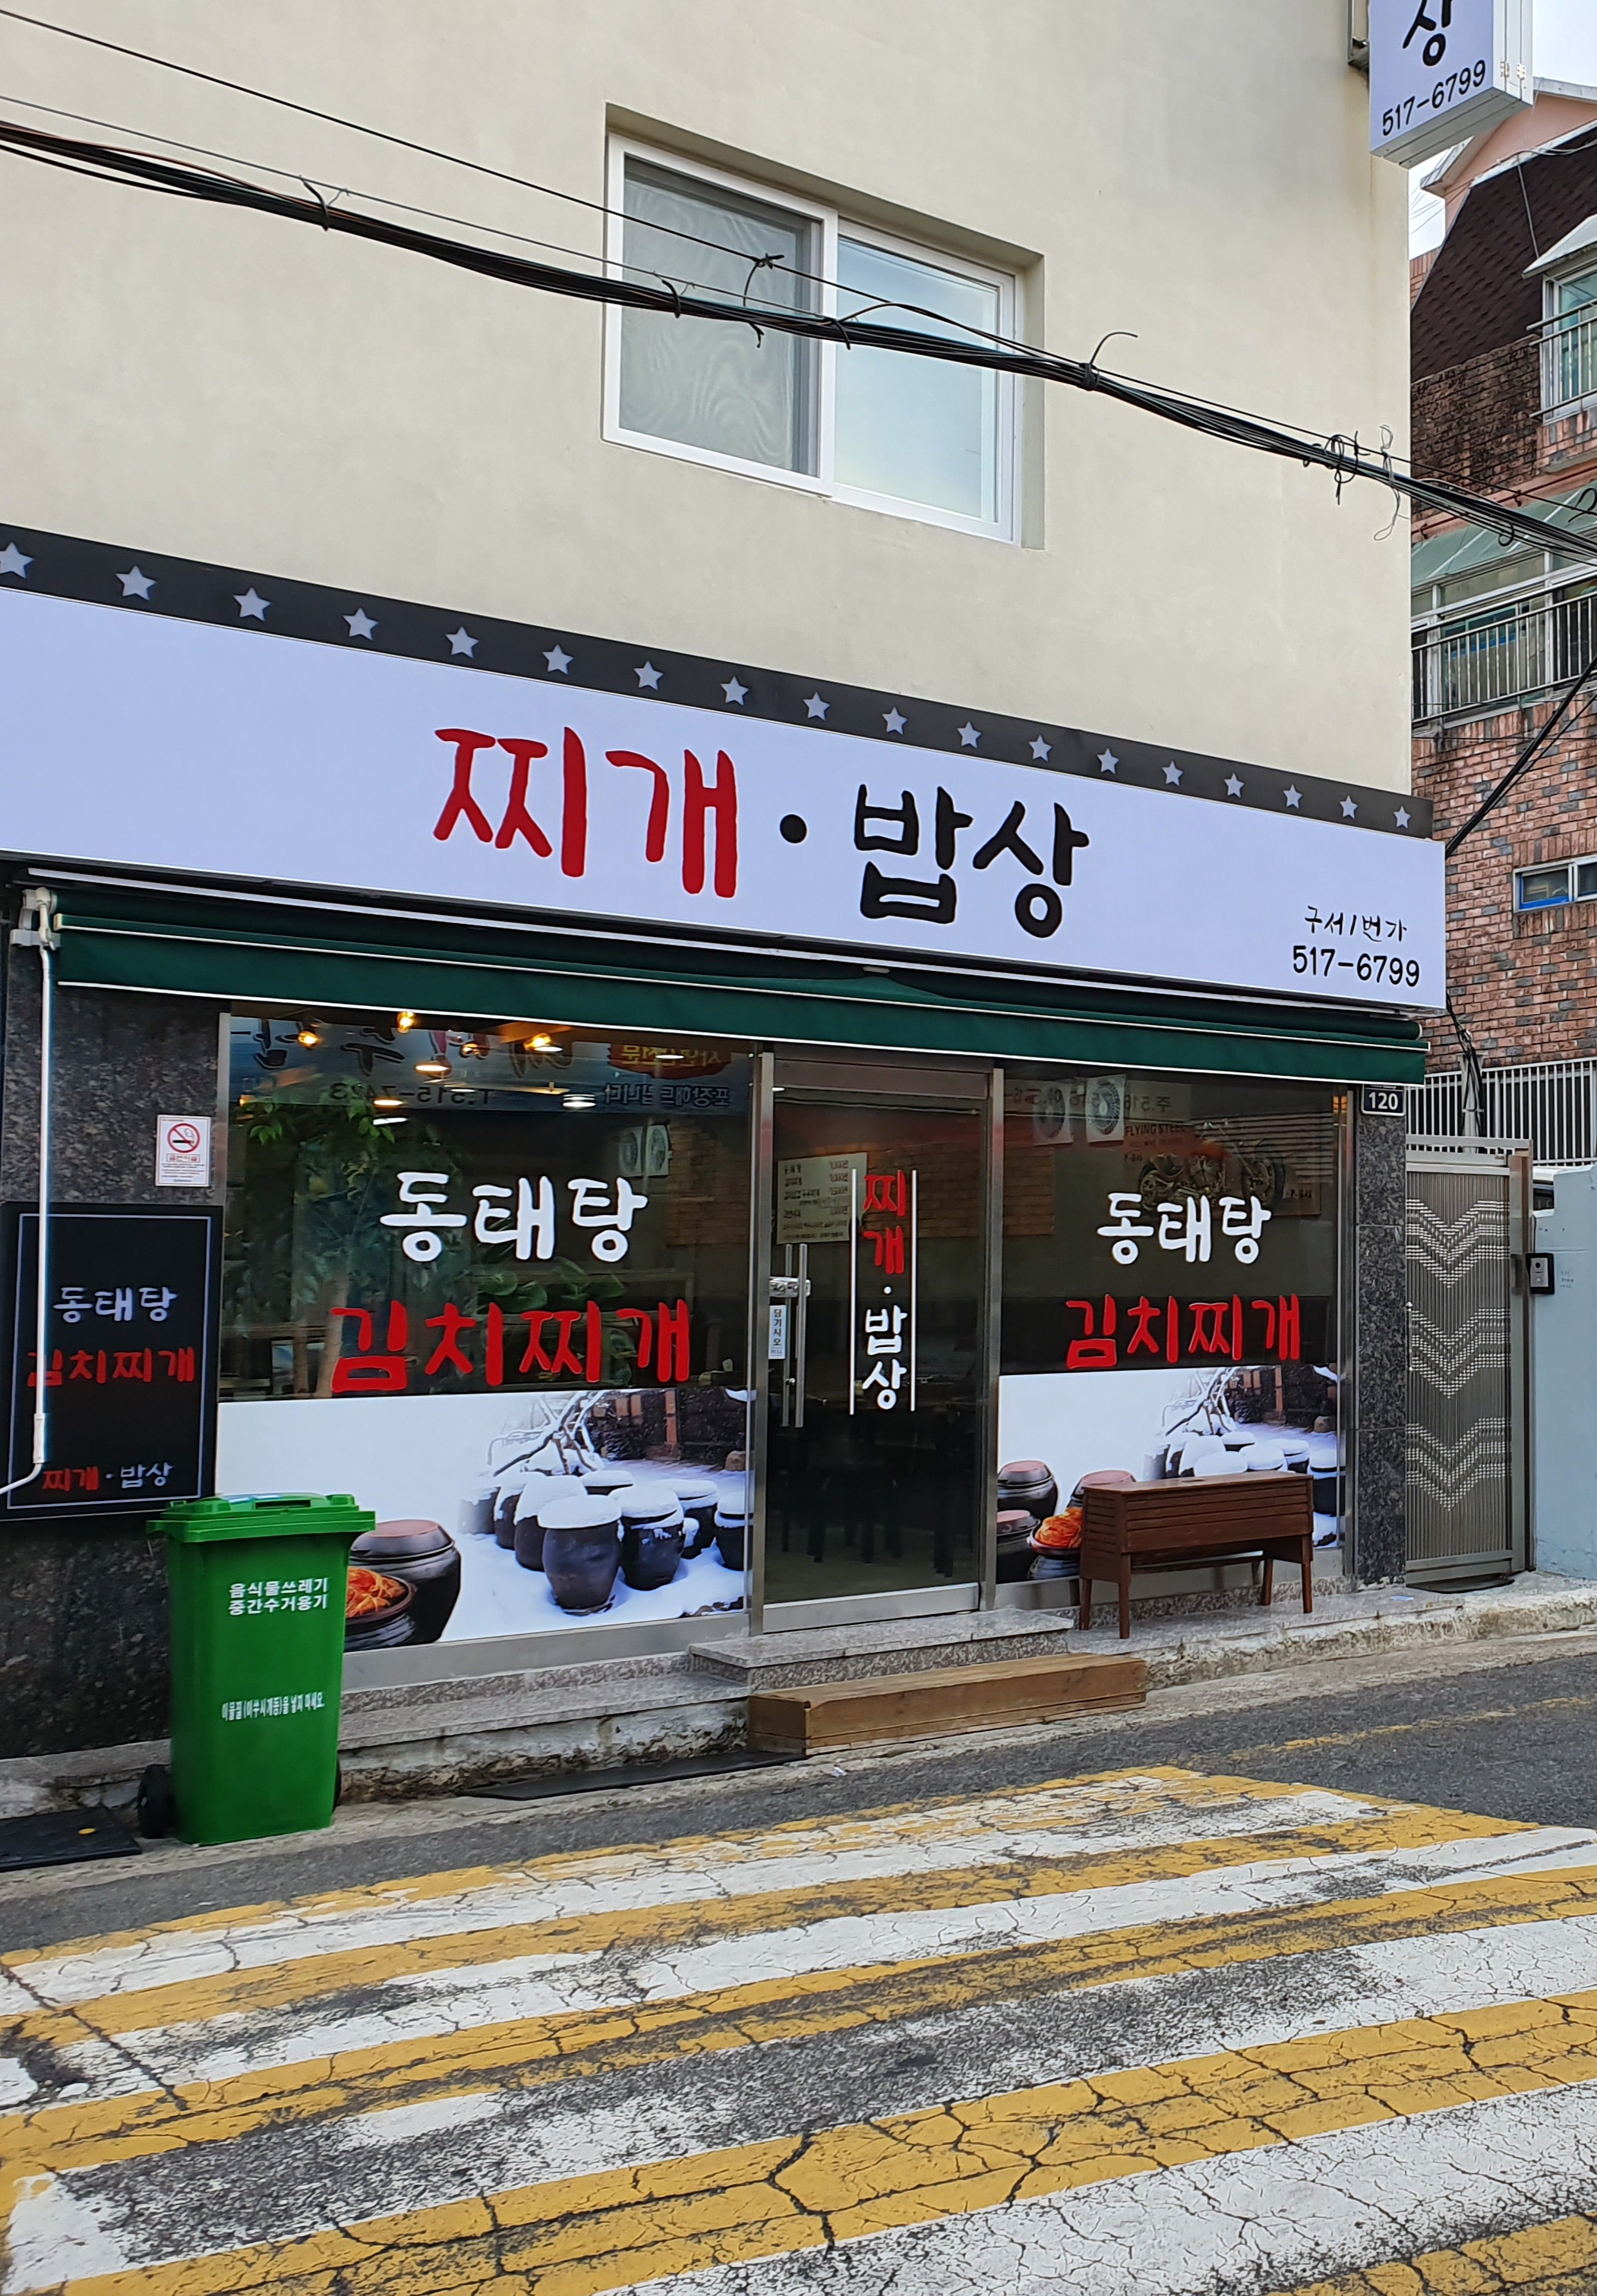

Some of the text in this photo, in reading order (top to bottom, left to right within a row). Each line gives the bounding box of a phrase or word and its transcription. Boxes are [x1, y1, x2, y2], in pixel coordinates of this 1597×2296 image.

[1382, 59, 1486, 137] 517-6799
[434, 727, 738, 899] 찌개
[854, 784, 1090, 938] 밥상
[1292, 945, 1420, 987] 517-6799
[1368, 1091, 1399, 1110] 120
[1125, 1124, 1157, 1137] FLYING
[379, 1171, 649, 1263] 동태탕
[1096, 1191, 1273, 1266] 동태탕
[53, 1286, 178, 1323] 동태탕
[330, 1298, 692, 1396] 김치찌개
[1065, 1293, 1302, 1370] 김치찌개
[43, 1466, 100, 1492] 찌개
[120, 1462, 173, 1489] 밥상
[228, 1594, 328, 1616] 중간수거용기
[229, 1577, 329, 1599] 음식물쓰레기
